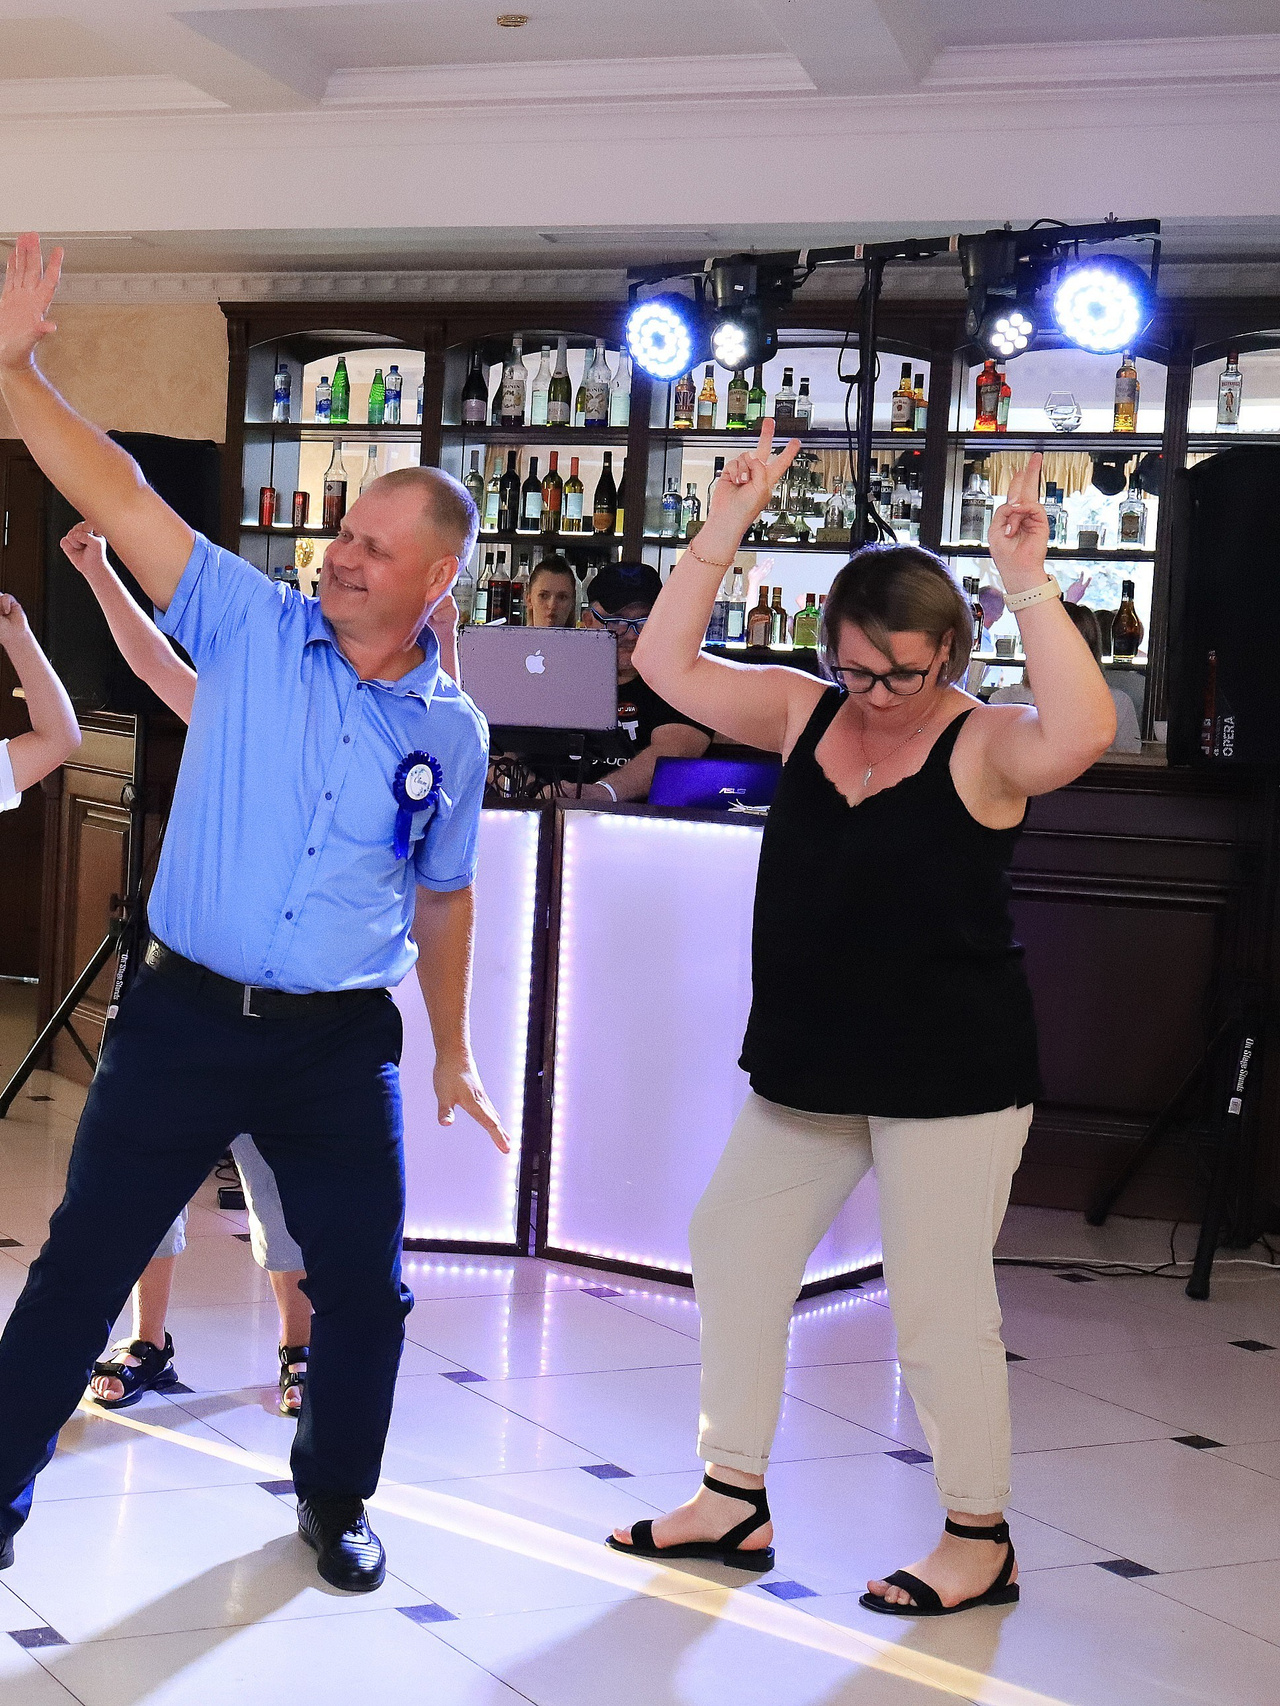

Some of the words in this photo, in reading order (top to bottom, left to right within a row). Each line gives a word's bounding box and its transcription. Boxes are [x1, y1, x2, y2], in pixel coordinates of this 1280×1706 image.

[1222, 716, 1235, 757] OPERA
[719, 787, 747, 795] ASUS
[1240, 1049, 1252, 1069] Stage
[1236, 1069, 1248, 1092] Stands
